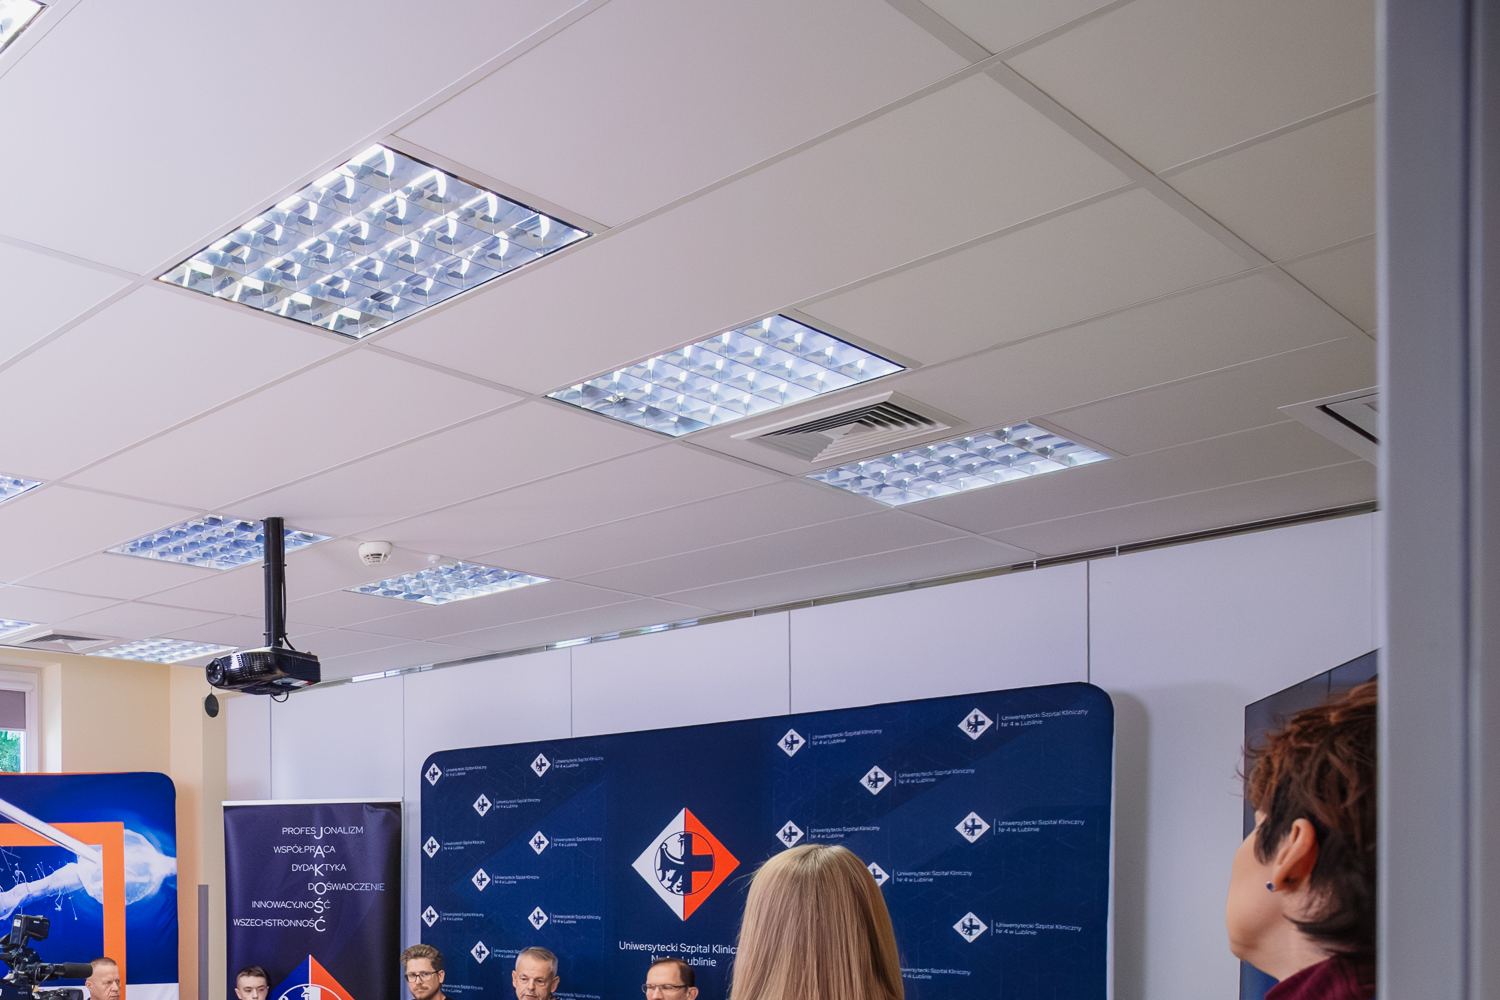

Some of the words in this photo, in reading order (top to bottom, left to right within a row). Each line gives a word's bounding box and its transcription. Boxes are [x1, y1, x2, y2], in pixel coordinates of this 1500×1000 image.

[282, 826, 364, 840] PROFESJONALIZM
[273, 844, 336, 858] WSPÓŁPRACA
[291, 864, 347, 876] DYDAKTYKA
[308, 881, 386, 895] DOŚWIADCZENIE
[251, 897, 330, 914] INNOWACYJNOŚĆ
[233, 916, 326, 932] WSZECHSTRONNOŚĆ
[619, 941, 678, 954] Uniwersytecki
[680, 943, 710, 954] Szpital
[712, 944, 738, 954] Klinic
[682, 956, 717, 966] ublinie
